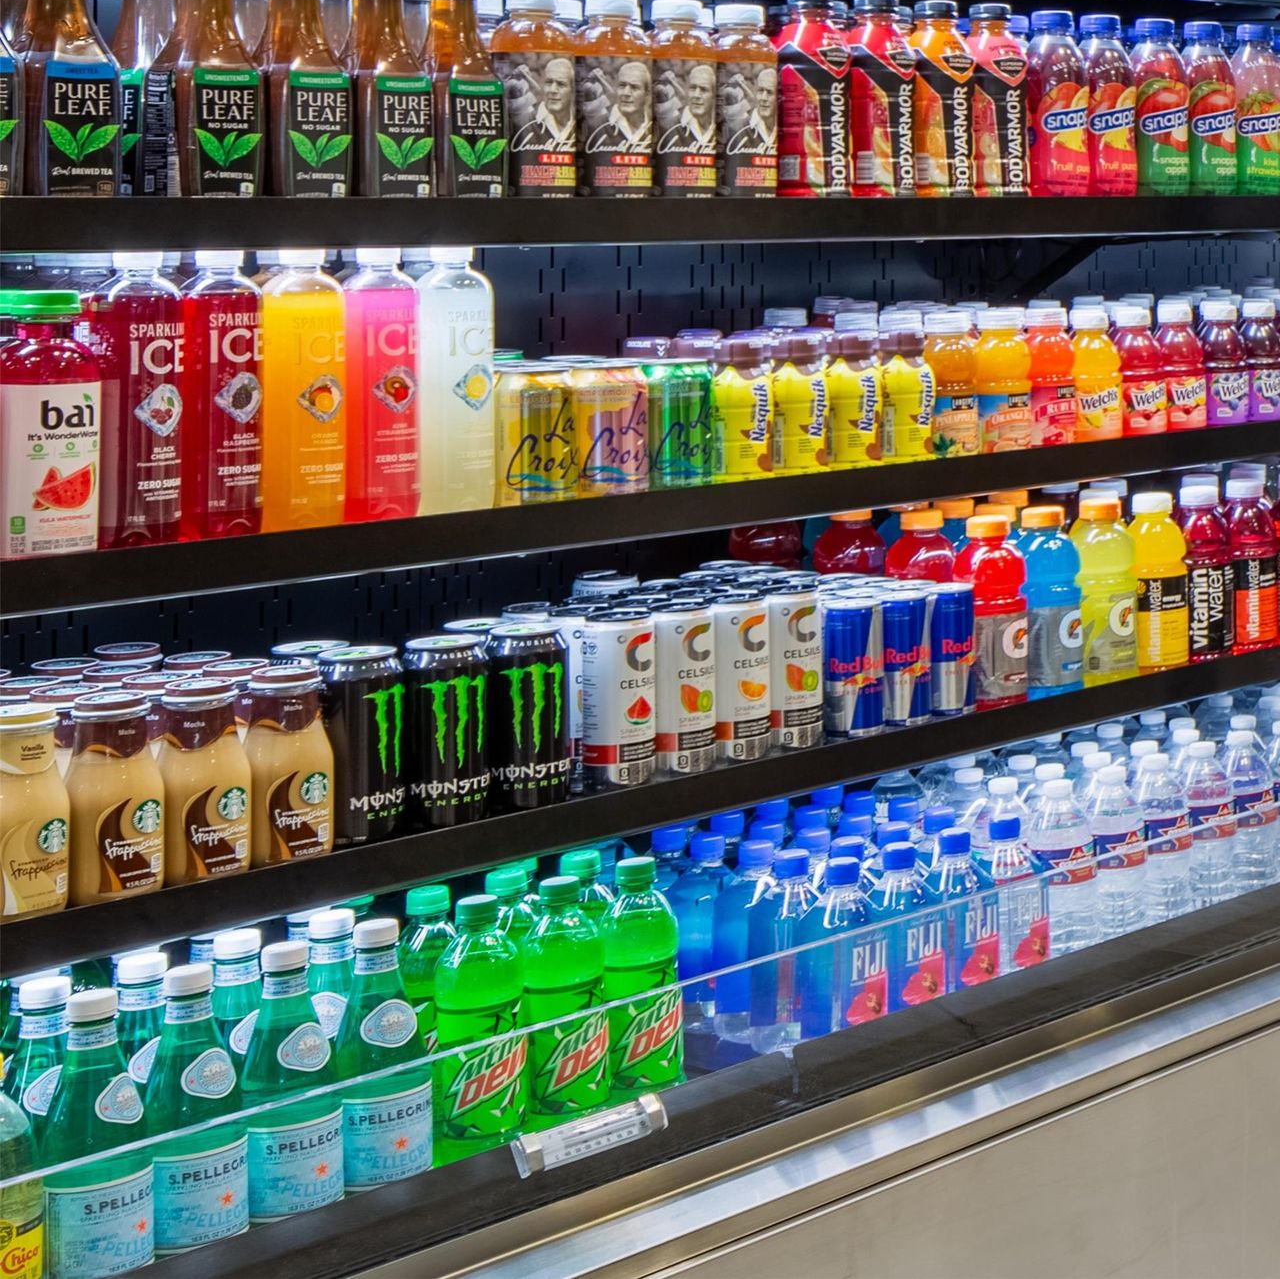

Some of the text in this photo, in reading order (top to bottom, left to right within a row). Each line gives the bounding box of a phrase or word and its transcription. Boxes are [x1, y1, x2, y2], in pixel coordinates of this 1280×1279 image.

[204, 74, 250, 82] UNSWEETENED
[54, 82, 111, 99] PURE
[202, 89, 255, 105] PURE
[296, 91, 347, 107] PURE
[383, 95, 430, 110] PURE
[456, 98, 500, 113] PURE
[831, 81, 845, 190] BODYARMOR
[899, 83, 913, 189] BODYARMOR
[954, 86, 968, 190] BODYARMOR
[1007, 89, 1021, 193] BODYARMOR
[543, 155, 572, 164] LITE
[616, 156, 647, 165] LITE
[687, 157, 714, 165] LITE
[71, 166, 113, 176] BREWED TEA
[129, 339, 184, 375] ICE
[808, 377, 825, 438] Nesquik
[858, 373, 876, 433] Nesquik
[917, 369, 933, 427] Nesquik
[1080, 387, 1119, 411] Welch's
[41, 394, 95, 430] bai
[544, 397, 575, 444] La
[622, 391, 647, 436] La
[751, 382, 769, 443] Nesquik
[27, 433, 43, 442] It's
[150, 452, 176, 462] CHERRY
[153, 445, 175, 454] BLACK
[375, 454, 398, 463] ZERO
[217, 466, 241, 475] ZERO
[300, 464, 323, 474] ZERO
[137, 480, 160, 490] ZERO
[1208, 568, 1224, 622] water
[1247, 558, 1260, 640] vitaminwater
[1188, 568, 1209, 652] vitamin
[783, 645, 821, 660] CELSIUS
[886, 647, 917, 664] Red
[942, 639, 971, 654] Red
[830, 657, 861, 674] Red
[283, 704, 303, 712] Mocha
[118, 728, 136, 736] Mocha
[183, 721, 205, 729] Mocha
[491, 757, 571, 781] MONSTER
[503, 775, 567, 790] ENERGY
[425, 790, 488, 808] ENERGY
[274, 807, 330, 829] frappuccino
[190, 822, 248, 846] frappuccino
[105, 837, 162, 860] frappuccino
[1016, 889, 1049, 926] FIJI
[965, 905, 998, 945] FIJI
[906, 921, 942, 963] FIJI
[851, 940, 887, 982] FIJI
[348, 1100, 432, 1128] S.PELLEGRIN
[0, 1246, 39, 1274] Chico
